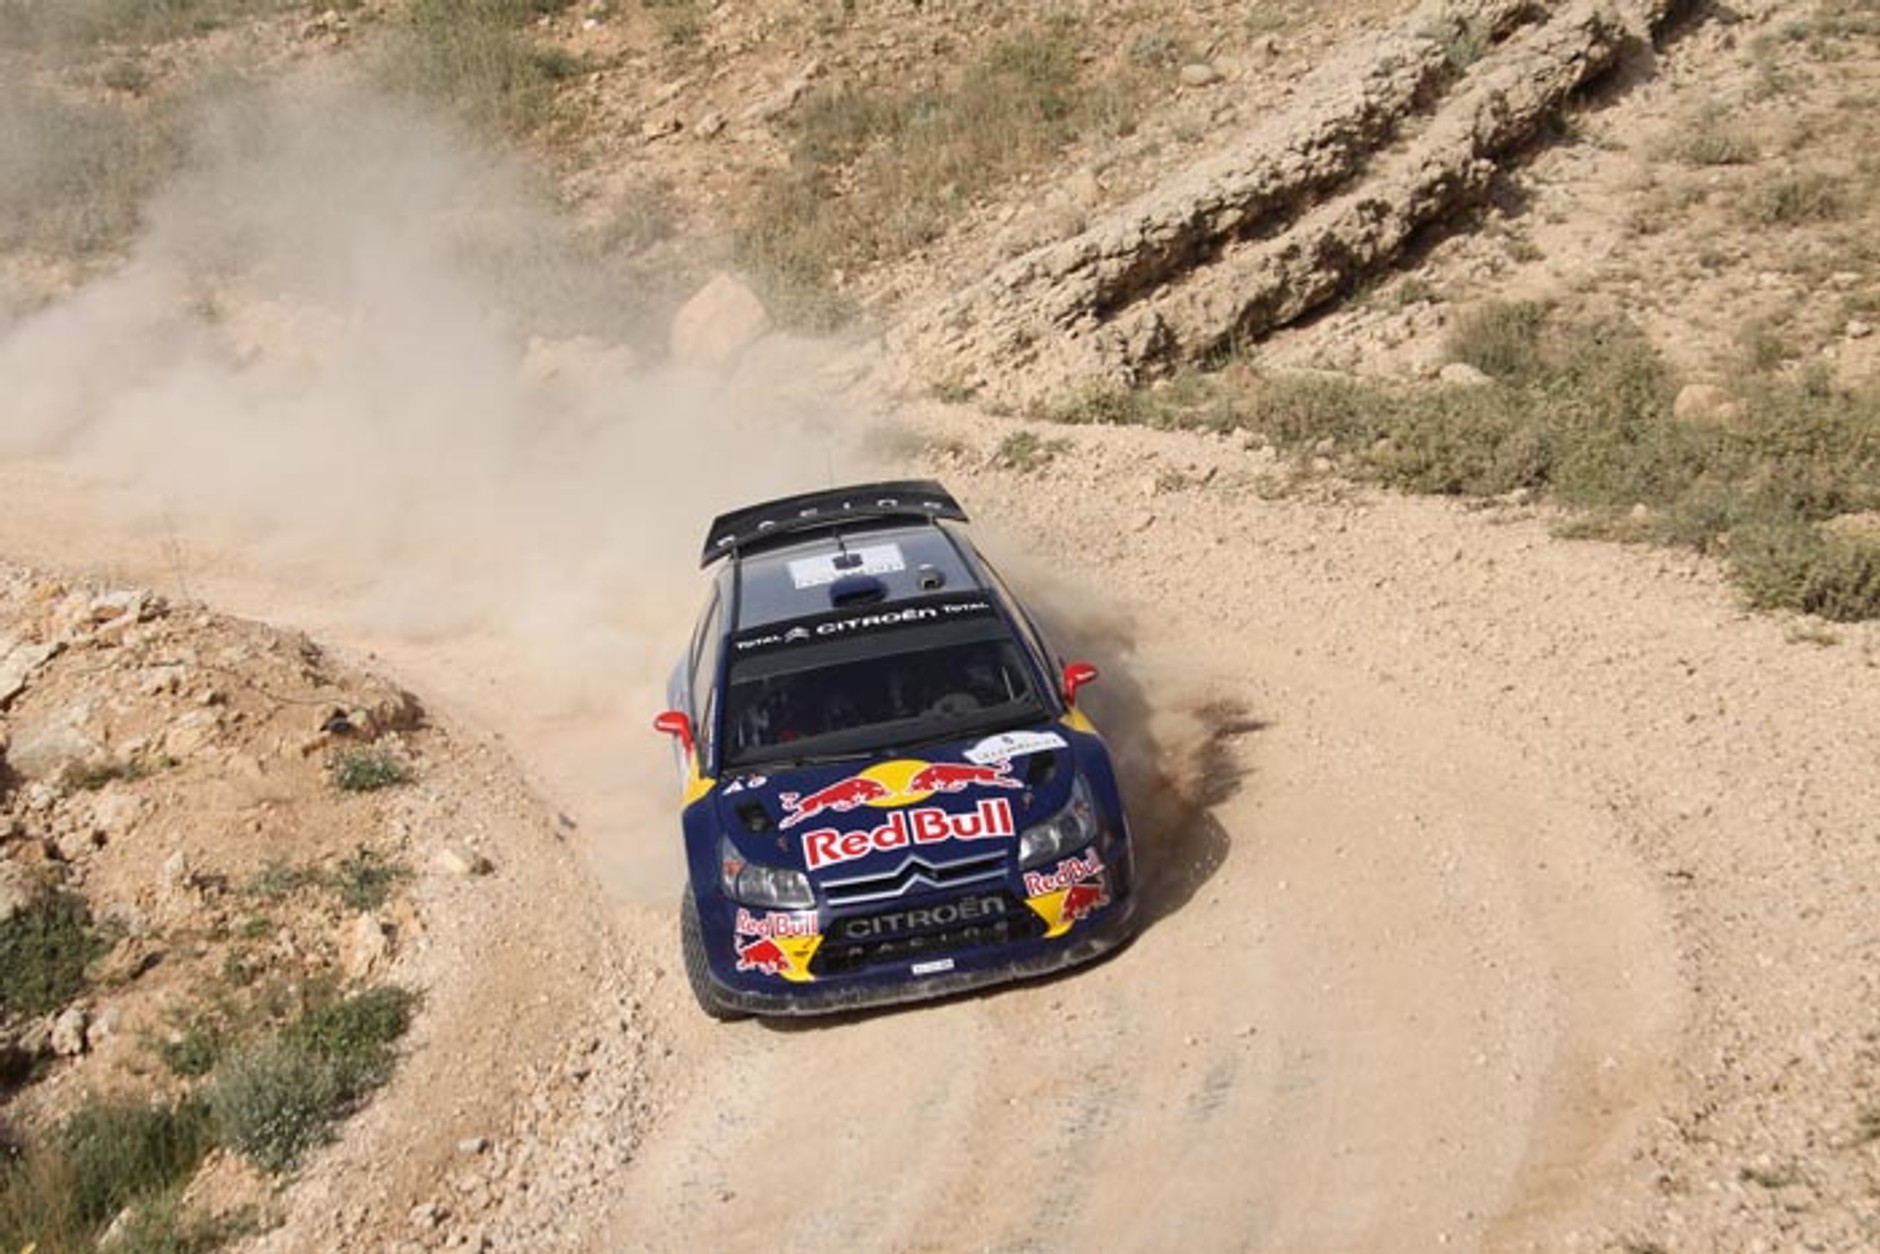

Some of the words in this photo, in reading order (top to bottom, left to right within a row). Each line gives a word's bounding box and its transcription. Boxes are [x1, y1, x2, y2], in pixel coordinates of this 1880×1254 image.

[736, 635, 783, 650] TOTAL
[942, 602, 990, 614] TOTAL
[803, 811, 910, 870] Red
[909, 798, 1015, 844] Bull
[1023, 860, 1072, 898] Red
[736, 908, 774, 936] Red
[773, 910, 819, 936] Bull
